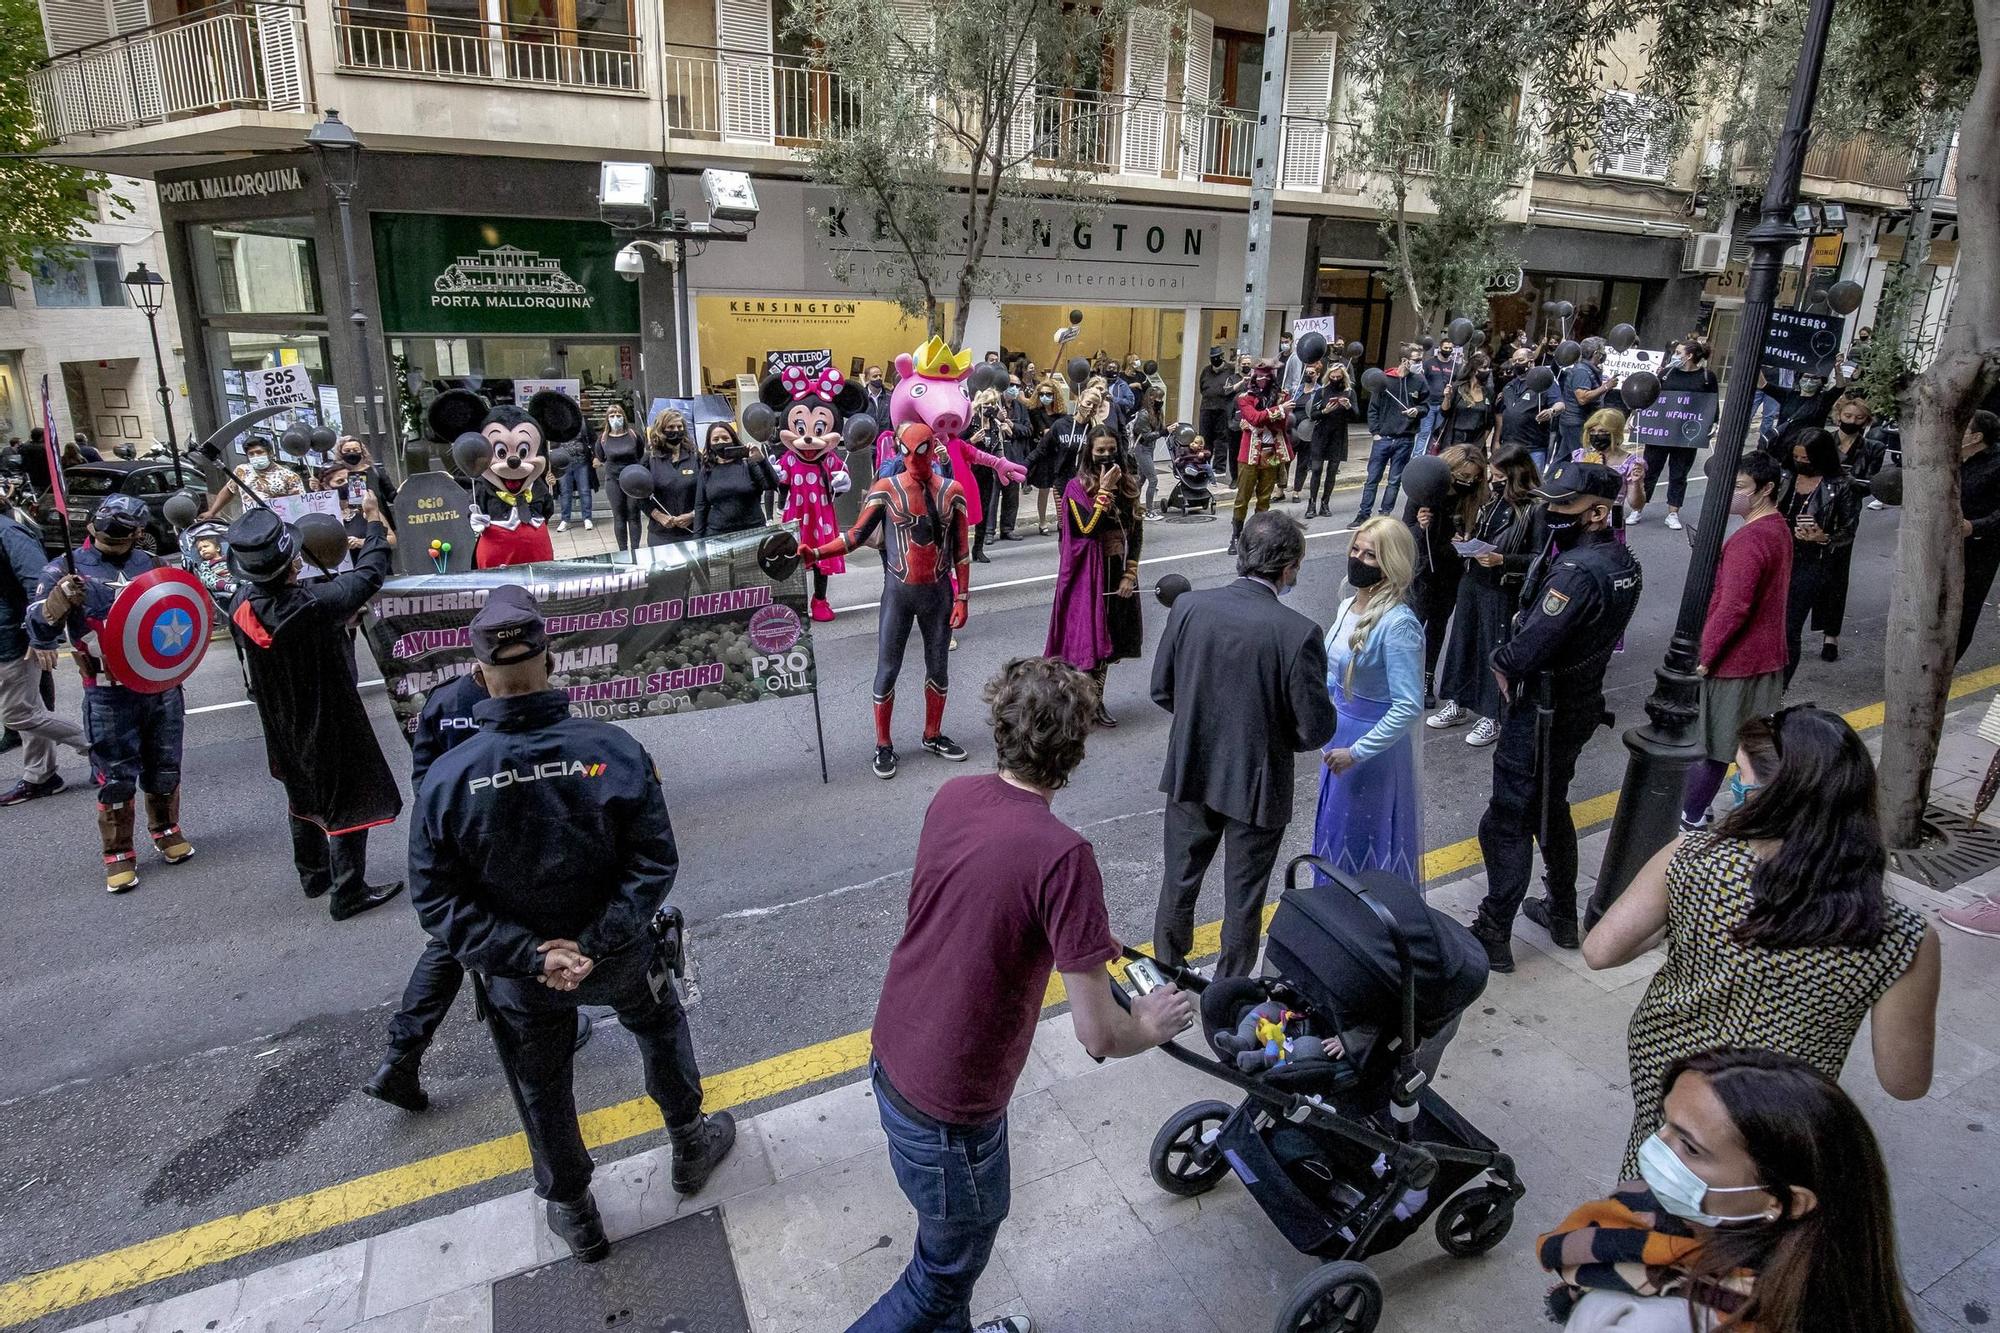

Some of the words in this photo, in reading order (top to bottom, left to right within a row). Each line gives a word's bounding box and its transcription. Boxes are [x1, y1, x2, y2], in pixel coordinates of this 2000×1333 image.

[159, 180, 200, 203] PORTA
[200, 167, 303, 199] MALLORQUINA
[1056, 271, 1185, 289] International
[431, 295, 480, 307] PORTA
[486, 296, 591, 308] MALLORQUINA
[730, 301, 855, 314] KENSINGTON
[1294, 319, 1329, 331] AYUDAS
[1772, 312, 1827, 329] ENTIERRO
[1770, 329, 1789, 338] CIO
[1607, 347, 1630, 357] SOO
[1765, 346, 1807, 364] NFANTIL
[802, 365, 815, 377] IO
[1603, 359, 1651, 371] QUEREMOS
[263, 369, 296, 386] SOS
[301, 491, 332, 503] MAGIC
[374, 589, 489, 618] #ENTIERRO
[557, 569, 649, 600] INFANTIL
[393, 627, 474, 659] #AYUDA
[544, 609, 628, 634] CIFICAS
[633, 599, 683, 625] OCIO
[687, 585, 774, 617] INFANTIL
[496, 628, 522, 639] CNP
[751, 651, 808, 679] PRO
[646, 663, 725, 694] SEGURO
[571, 694, 691, 719] allorca.com
[440, 717, 480, 731] POL
[468, 759, 588, 796] POLICIA
